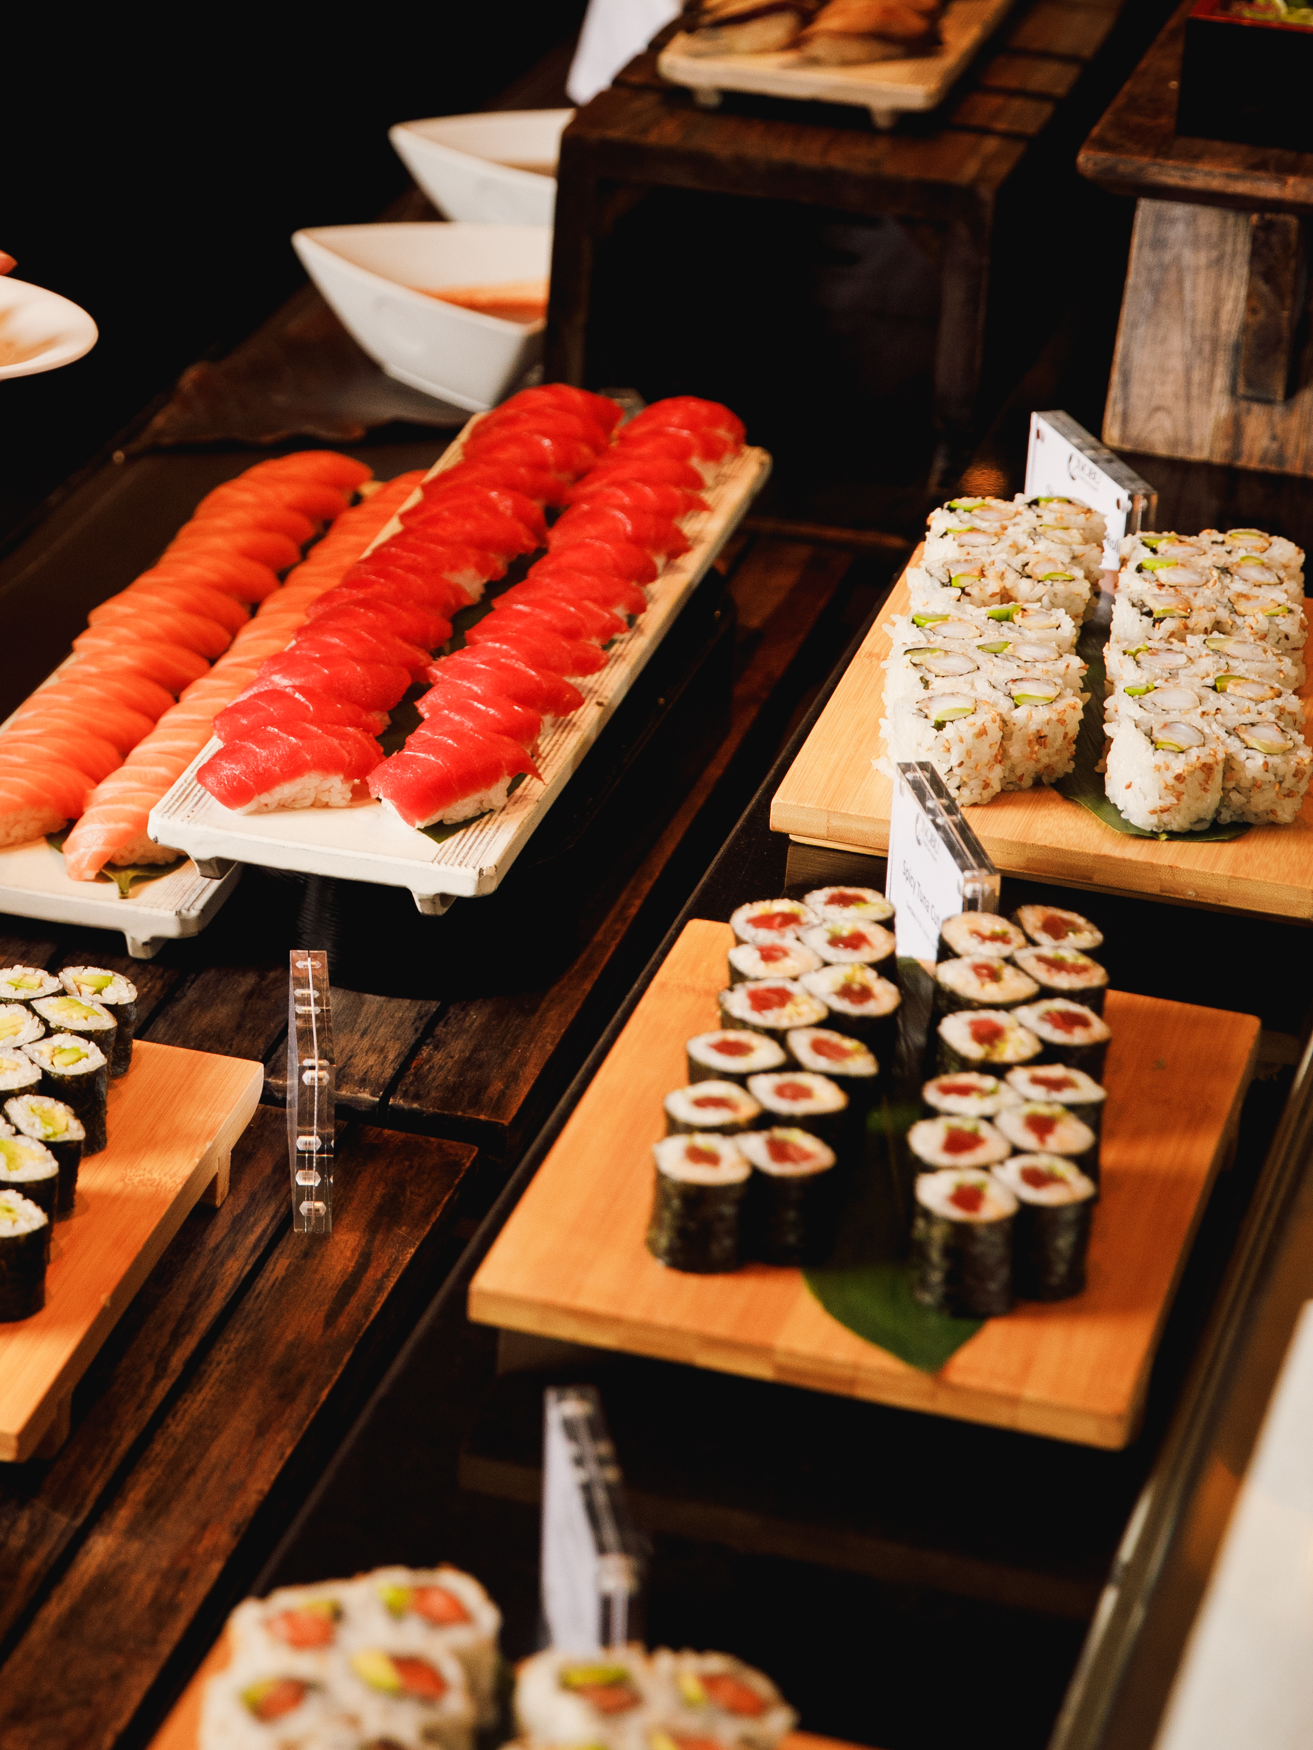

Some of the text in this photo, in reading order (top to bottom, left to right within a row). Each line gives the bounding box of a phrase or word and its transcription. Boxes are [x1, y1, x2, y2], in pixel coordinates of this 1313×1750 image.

[921, 815, 941, 854] NOBU
[902, 859, 917, 895] Spicy
[917, 880, 930, 913] Tuna
